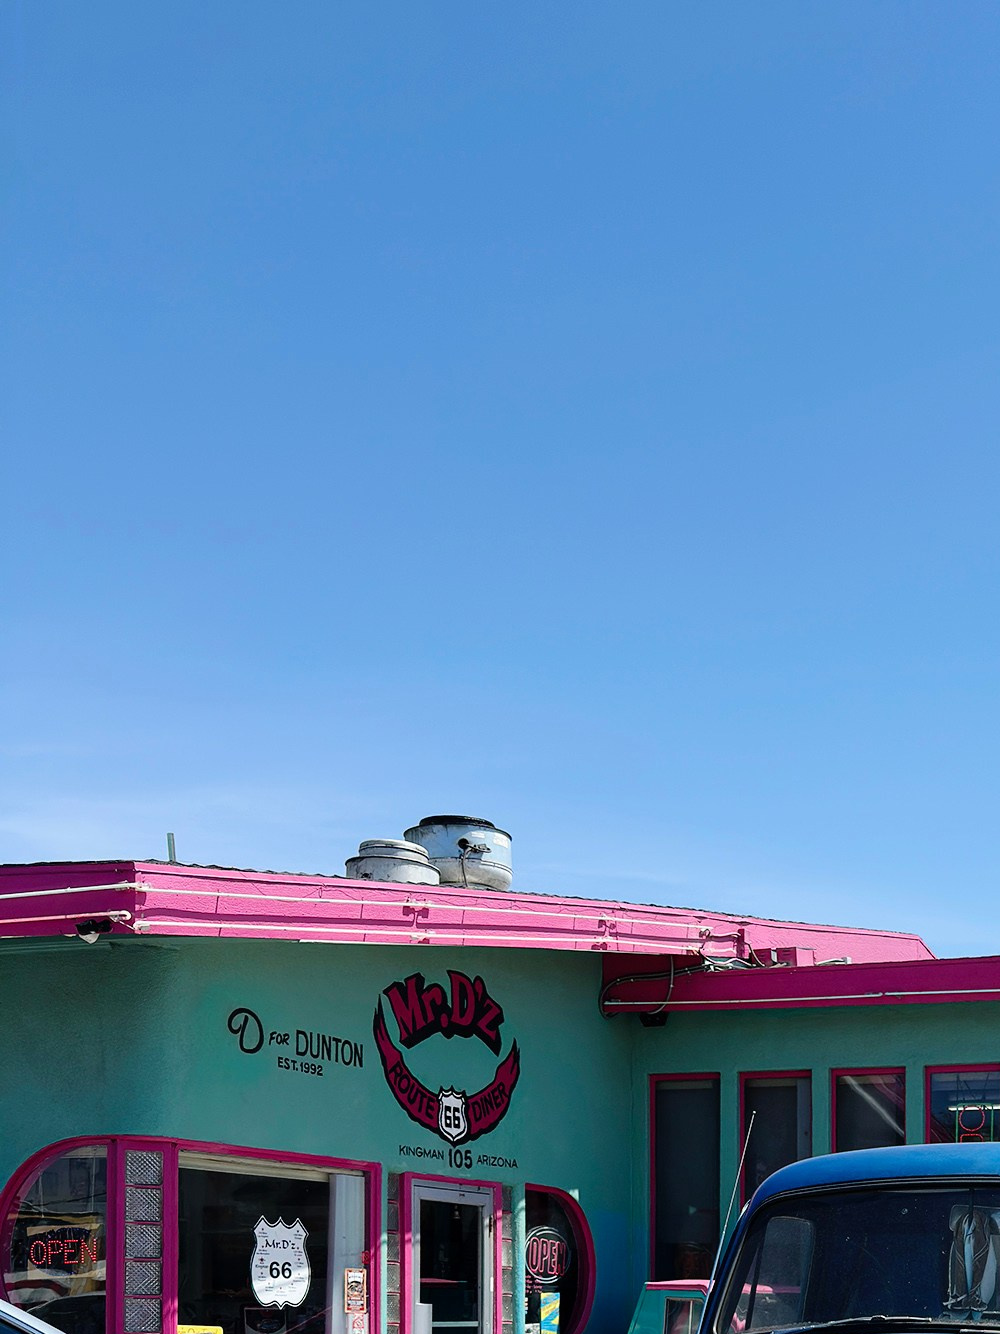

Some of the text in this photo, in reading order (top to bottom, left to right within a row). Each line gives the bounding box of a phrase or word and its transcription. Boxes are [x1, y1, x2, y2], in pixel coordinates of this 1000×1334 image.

[228, 1008, 363, 1067] D FOR DUNTON
[389, 1061, 509, 1129] ROUTE 66 DINER
[399, 1145, 518, 1169] KINGMAN 105 ARIZONA
[30, 1238, 97, 1265] OPEN
[528, 1236, 566, 1276] OPEN
[269, 1261, 292, 1279] 66
